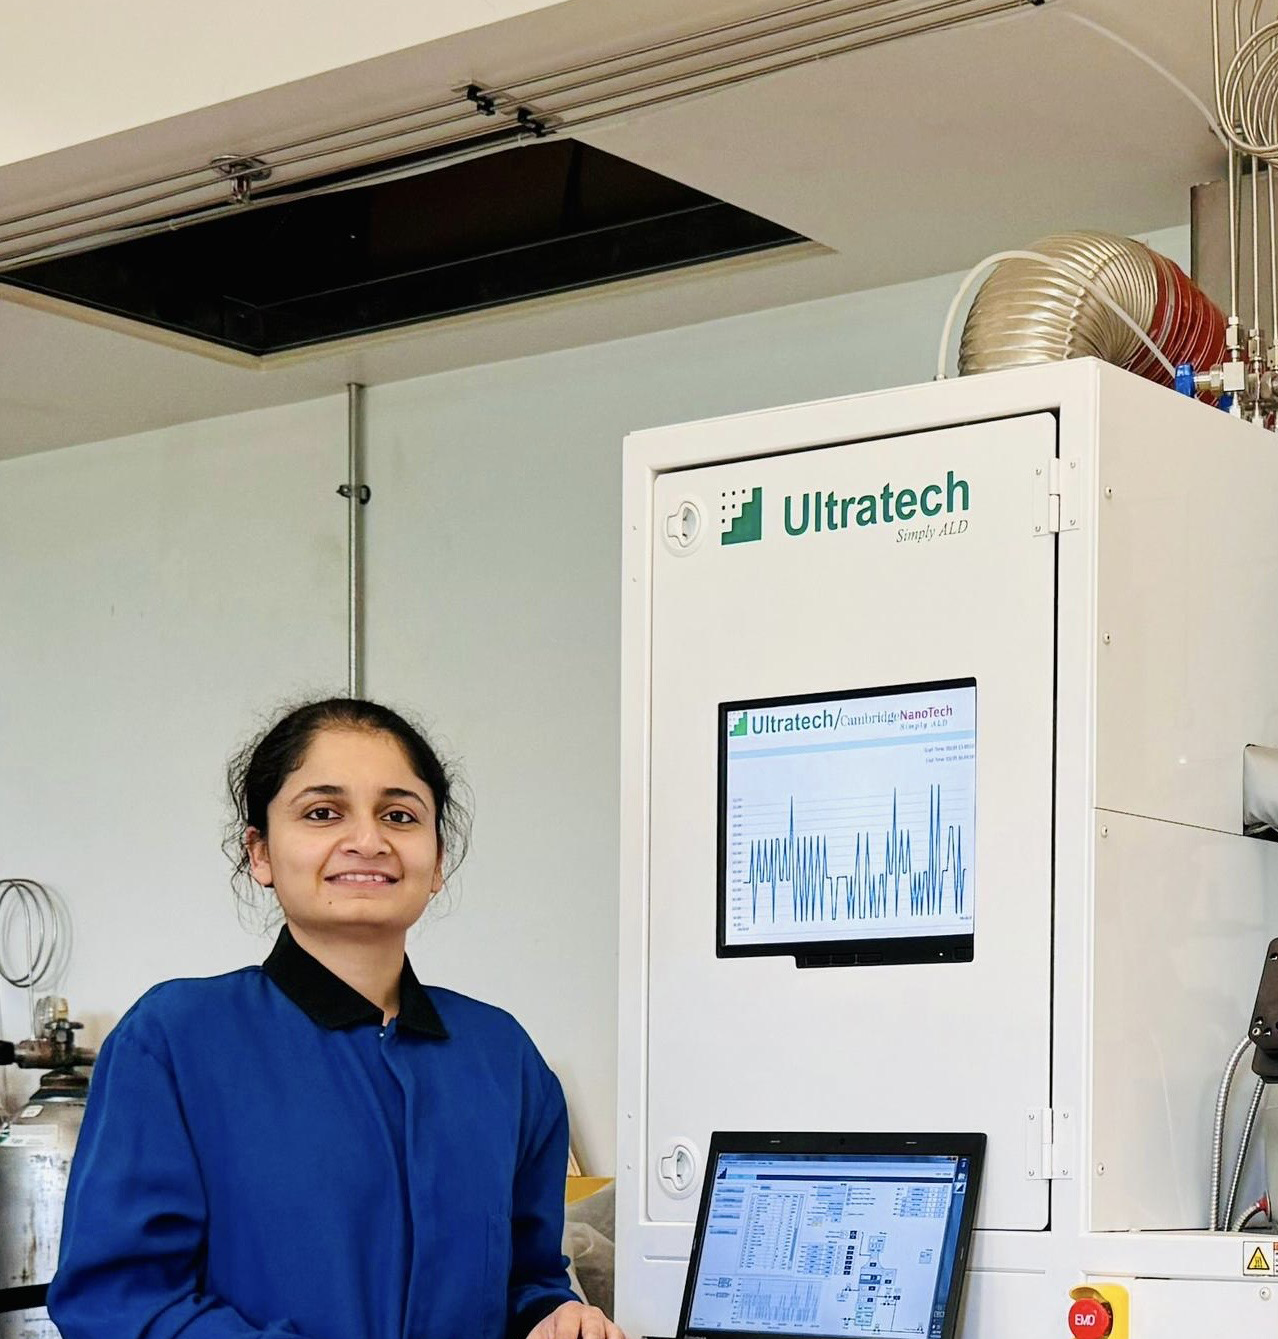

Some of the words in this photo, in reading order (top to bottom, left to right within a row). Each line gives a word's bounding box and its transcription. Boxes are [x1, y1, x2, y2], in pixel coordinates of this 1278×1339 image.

[784, 470, 970, 537] Ultratech
[896, 524, 936, 543] Simply
[938, 519, 969, 537] ALD
[899, 721, 928, 732] Simply
[1074, 1313, 1096, 1327] EMO
